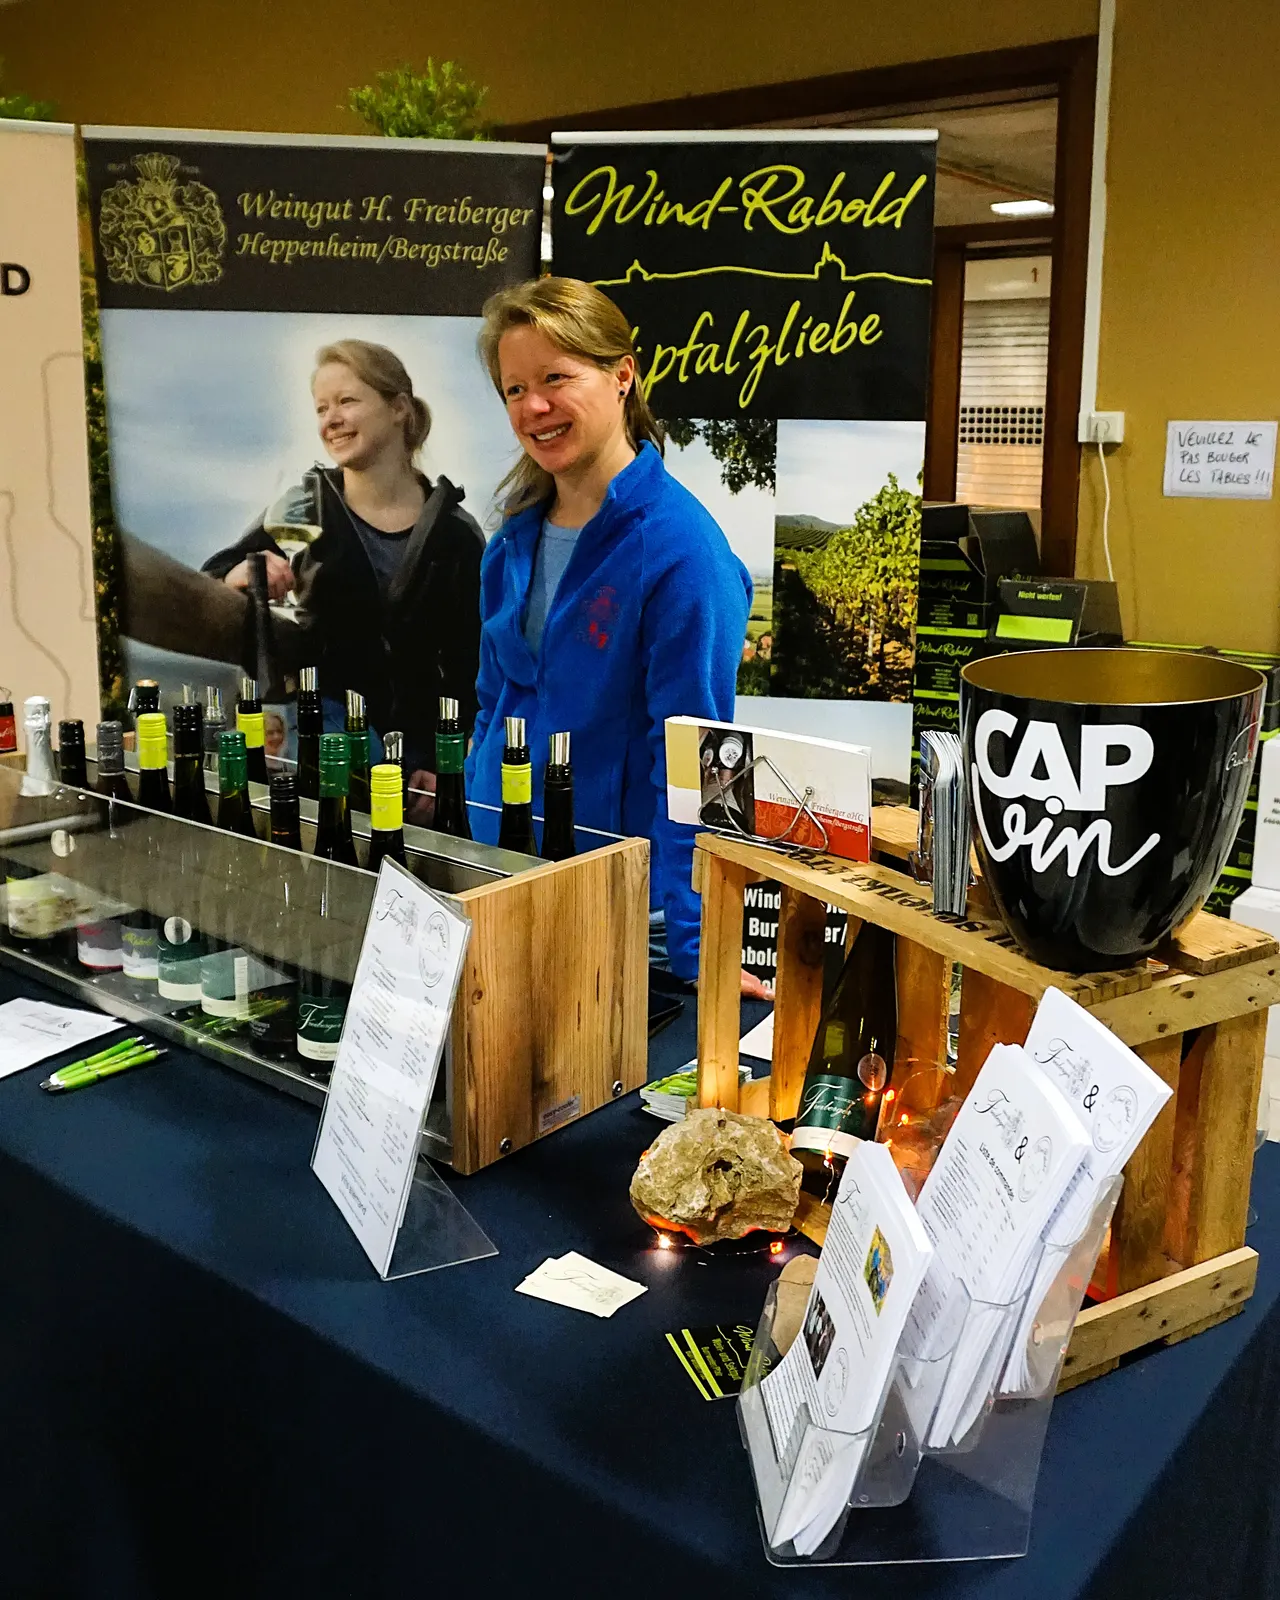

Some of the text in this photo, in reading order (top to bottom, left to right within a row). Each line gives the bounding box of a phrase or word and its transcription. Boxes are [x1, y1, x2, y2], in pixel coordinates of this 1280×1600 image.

[237, 190, 534, 234] Weingut H. Freiberger
[565, 164, 927, 236] Wind-Rabold
[235, 232, 508, 270] Heppenheim/Bergstraße
[630, 291, 883, 409] pfalzliebe
[1178, 426, 1234, 448] VEUILLEZ
[1180, 450, 1250, 464] PAS BOUGER
[1179, 468, 1201, 483] LES
[1211, 468, 1251, 485] TABLES
[975, 708, 1155, 812] CAP
[1083, 1084, 1100, 1114] &
[1014, 1136, 1029, 1165] &
